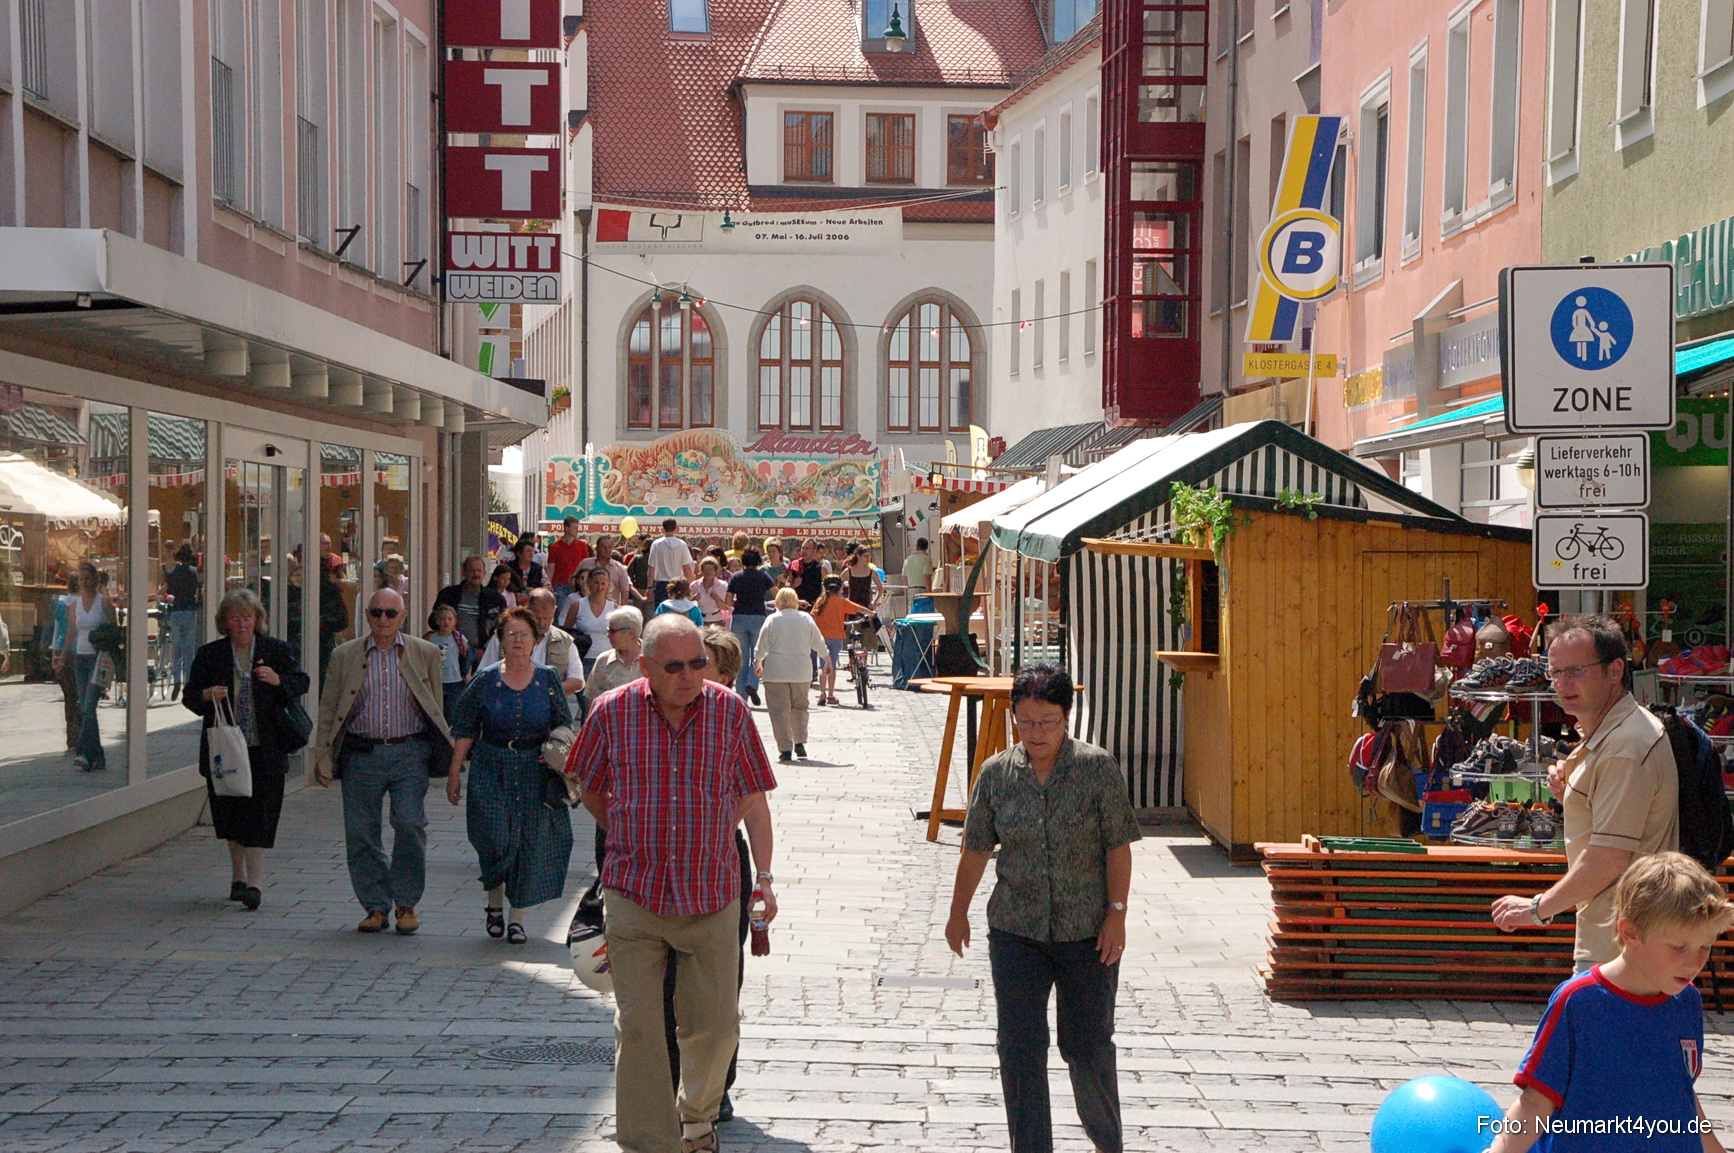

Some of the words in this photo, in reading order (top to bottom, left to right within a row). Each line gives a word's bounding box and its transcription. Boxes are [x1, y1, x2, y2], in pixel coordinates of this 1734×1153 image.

[826, 218, 847, 226] Neue
[849, 218, 884, 226] Arbeiten
[451, 235, 556, 269] WITT
[1281, 231, 1326, 274] B
[450, 275, 557, 300] WEIDEN
[1326, 360, 1331, 370] 4
[1553, 387, 1632, 412] ZONE
[742, 426, 878, 456] Mandeln
[1551, 445, 1632, 460] Lieferverkehr
[1544, 465, 1599, 481] werktags
[1579, 483, 1606, 498] frei
[679, 526, 733, 534] MANDELN
[747, 526, 784, 535] NÜSSE
[796, 528, 861, 536] LEBKUCHEN
[1573, 563, 1606, 580] frei
